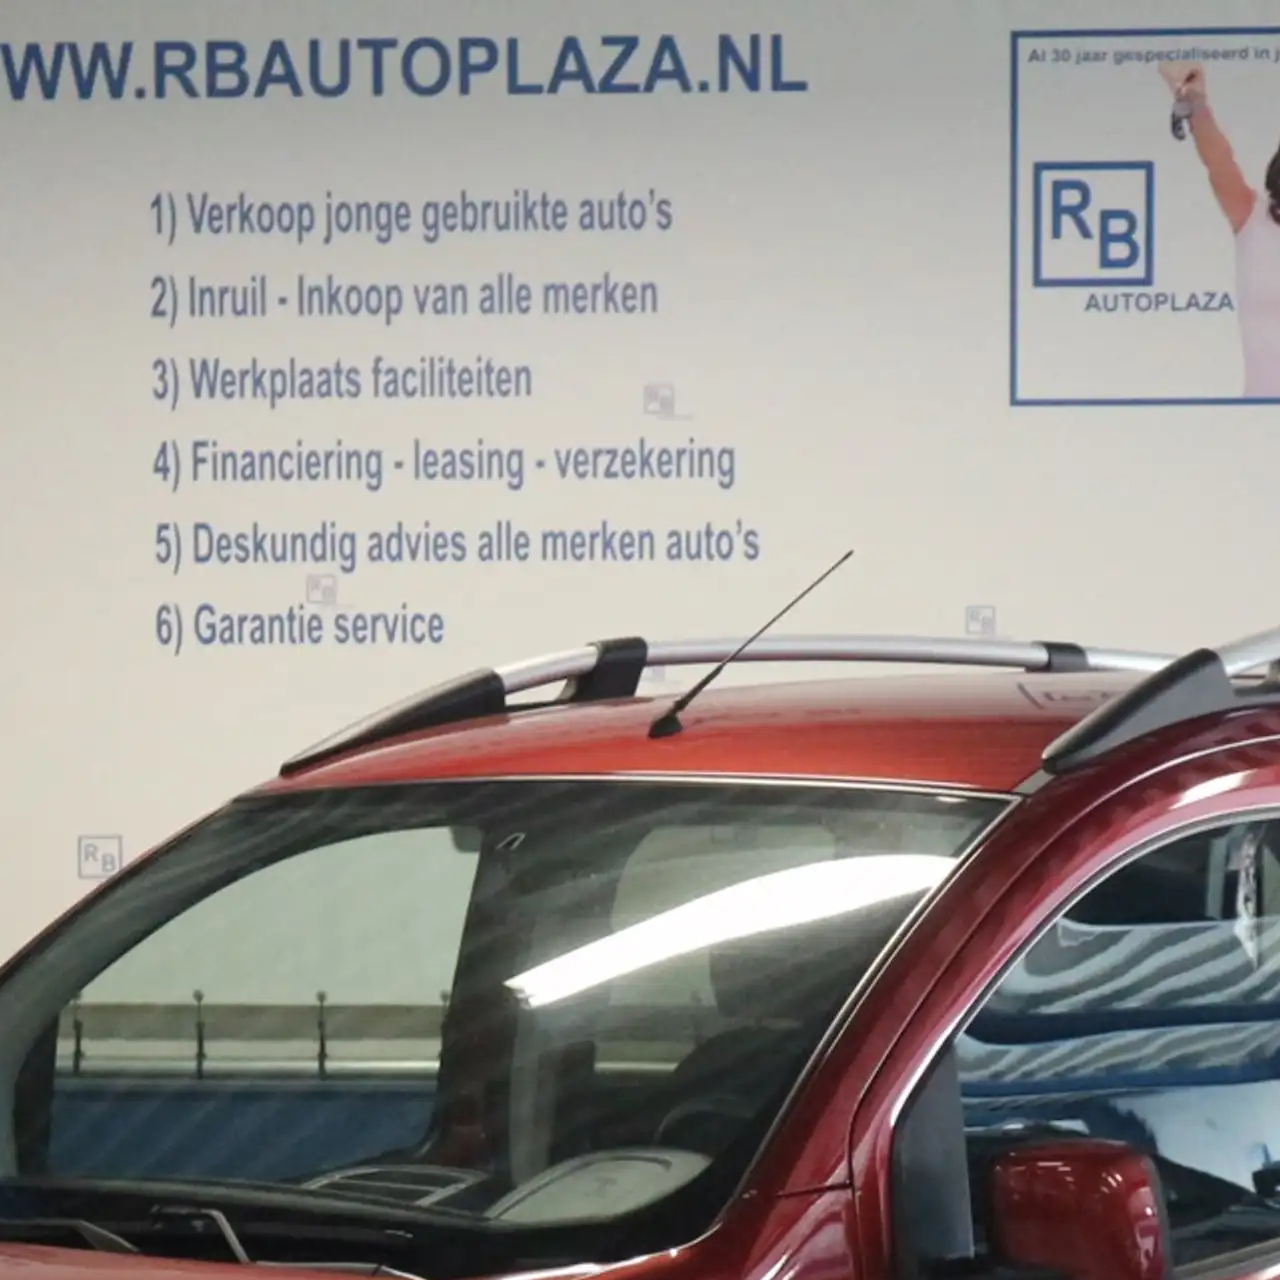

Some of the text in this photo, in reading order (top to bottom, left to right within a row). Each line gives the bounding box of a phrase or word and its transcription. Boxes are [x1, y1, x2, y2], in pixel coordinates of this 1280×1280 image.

[1051, 48, 1071, 63] 30
[1074, 49, 1108, 65] jaar
[1254, 46, 1271, 60] in
[150, 188, 673, 246] 1) Verkoop jonge gebruikte auto's
[1051, 180, 1140, 269] RB
[150, 275, 178, 329] 2)
[189, 274, 266, 317] Inruil
[298, 274, 403, 326] Inkoop
[413, 284, 467, 315] van
[479, 273, 532, 314] alle
[543, 272, 657, 314] merken
[1085, 292, 1234, 312] AUTOPLAZA
[152, 355, 531, 411] 3) Werkplaats faciliteiten
[153, 440, 181, 493] 4)
[192, 439, 382, 492] Financiering
[414, 438, 523, 491] leasing
[554, 437, 735, 490] verzekering
[155, 519, 760, 575] 5) Deskundig advies alle merken auto's
[156, 602, 444, 656] 6) Garantie service
